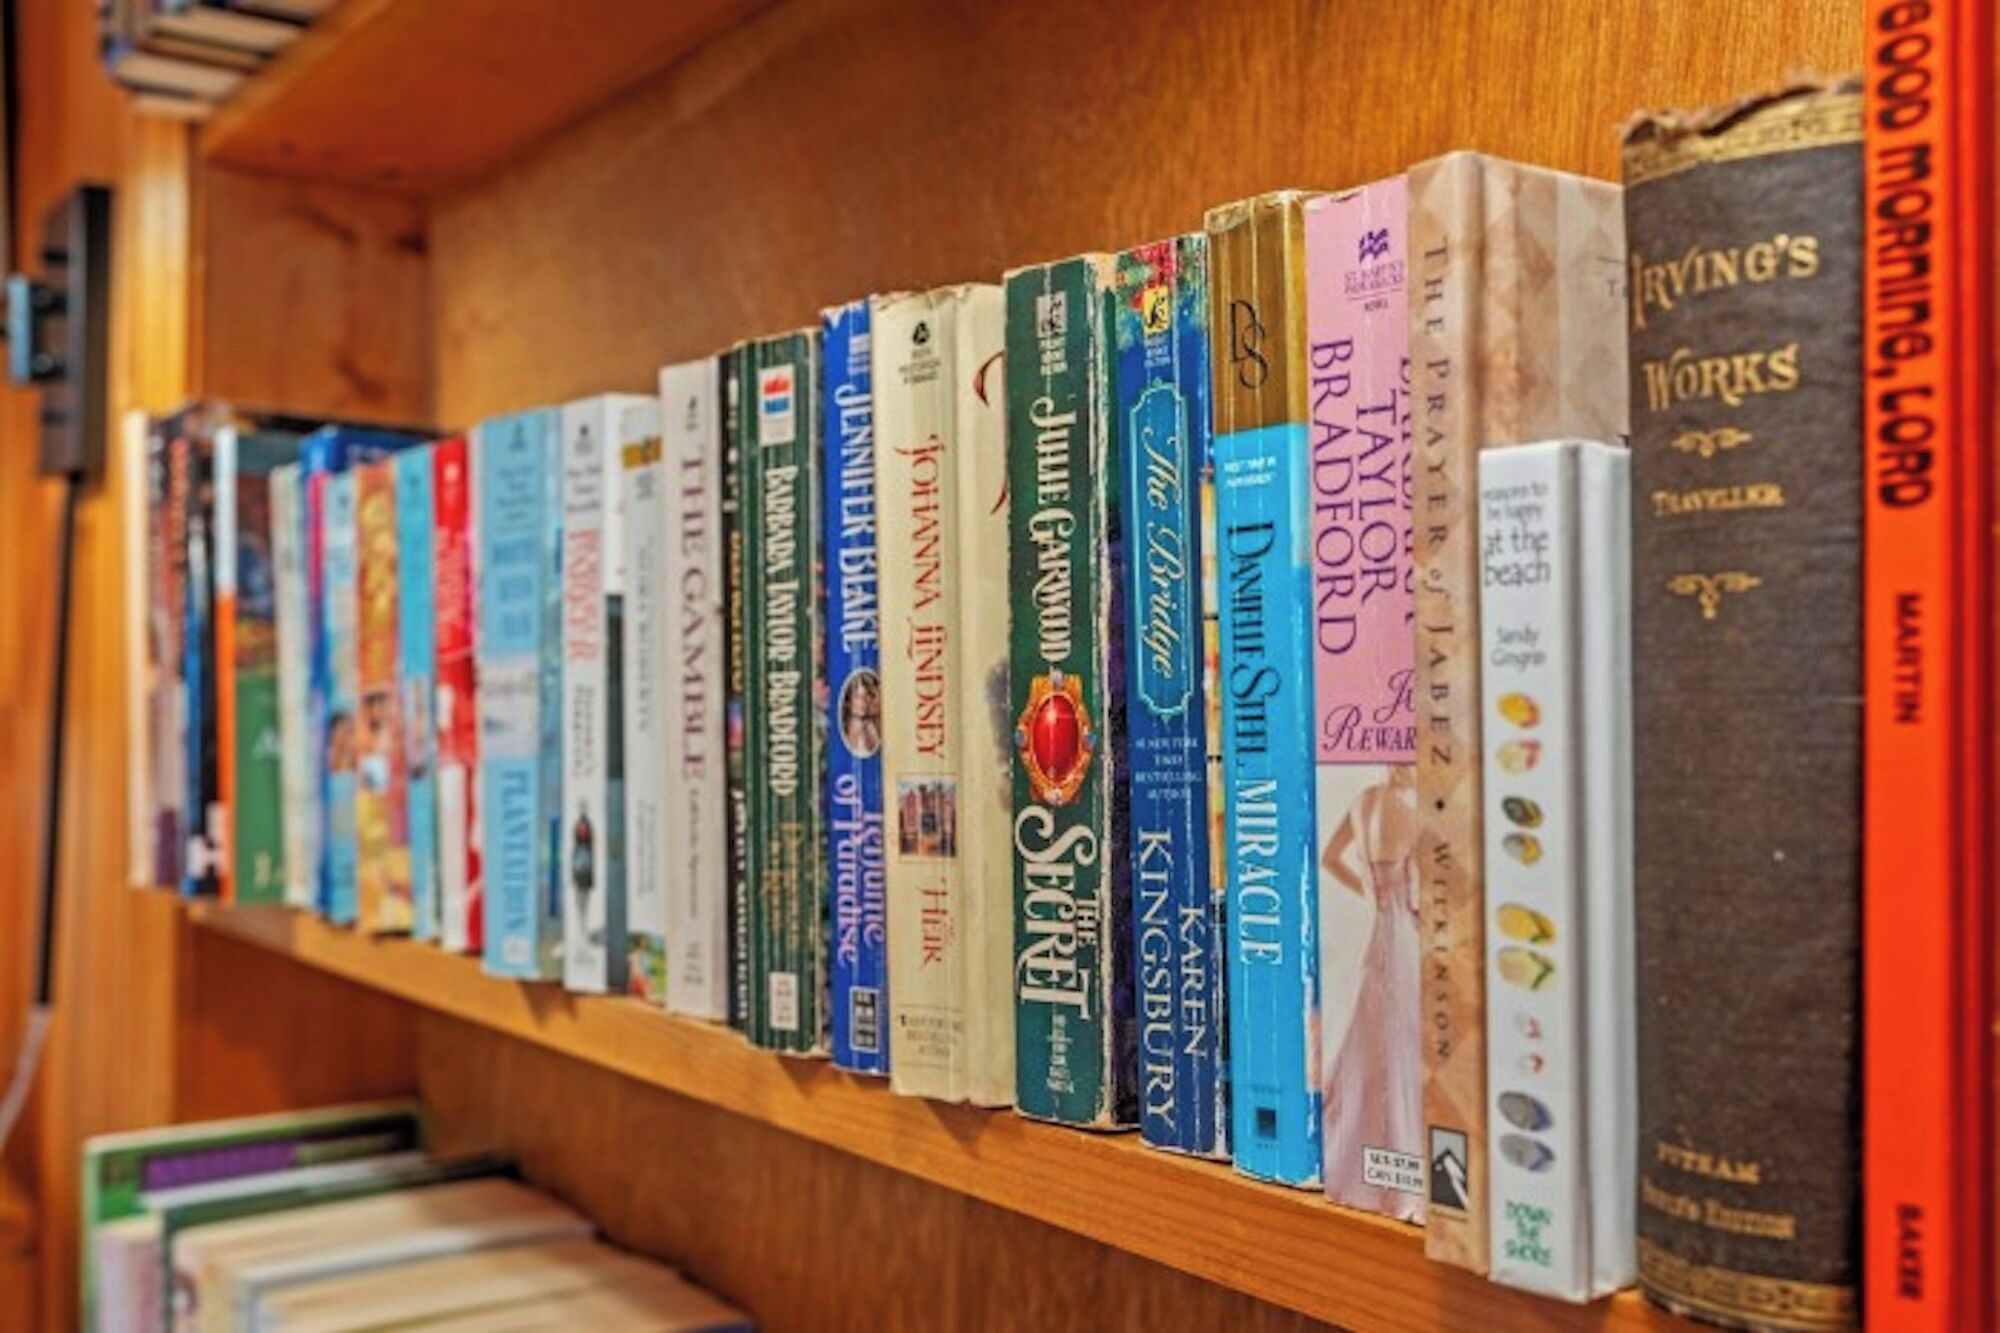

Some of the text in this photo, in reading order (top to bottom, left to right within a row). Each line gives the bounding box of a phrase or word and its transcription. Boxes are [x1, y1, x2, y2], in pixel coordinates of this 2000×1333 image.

[1877, 0, 1932, 131] GOOD
[1424, 235, 1449, 335] THE
[1631, 233, 1819, 331] IRVING'S
[1029, 395, 1077, 506] JULIE
[1643, 342, 1800, 413] WORKS
[1877, 386, 1935, 509] LORD
[834, 384, 877, 540] JENNIFER
[893, 433, 947, 610] JOHANNA
[1311, 335, 1358, 655] BRADFORD
[1356, 388, 1399, 606] TAYLOR
[1426, 358, 1450, 547] PRAYER
[840, 546, 880, 654] BLAKE
[1029, 507, 1078, 662] GARWOOD
[1141, 426, 1186, 680] The Bridge
[907, 616, 949, 760] LINDSEY
[1425, 624, 1454, 766] JABEZ
[1894, 593, 1922, 724] MARTIN
[1014, 804, 1098, 1021] SECRET
[1075, 888, 1101, 946] THE
[1235, 778, 1284, 967] MIRACLE
[1138, 826, 1177, 1133] KINGSBURY
[1178, 903, 1209, 1059] KAREN
